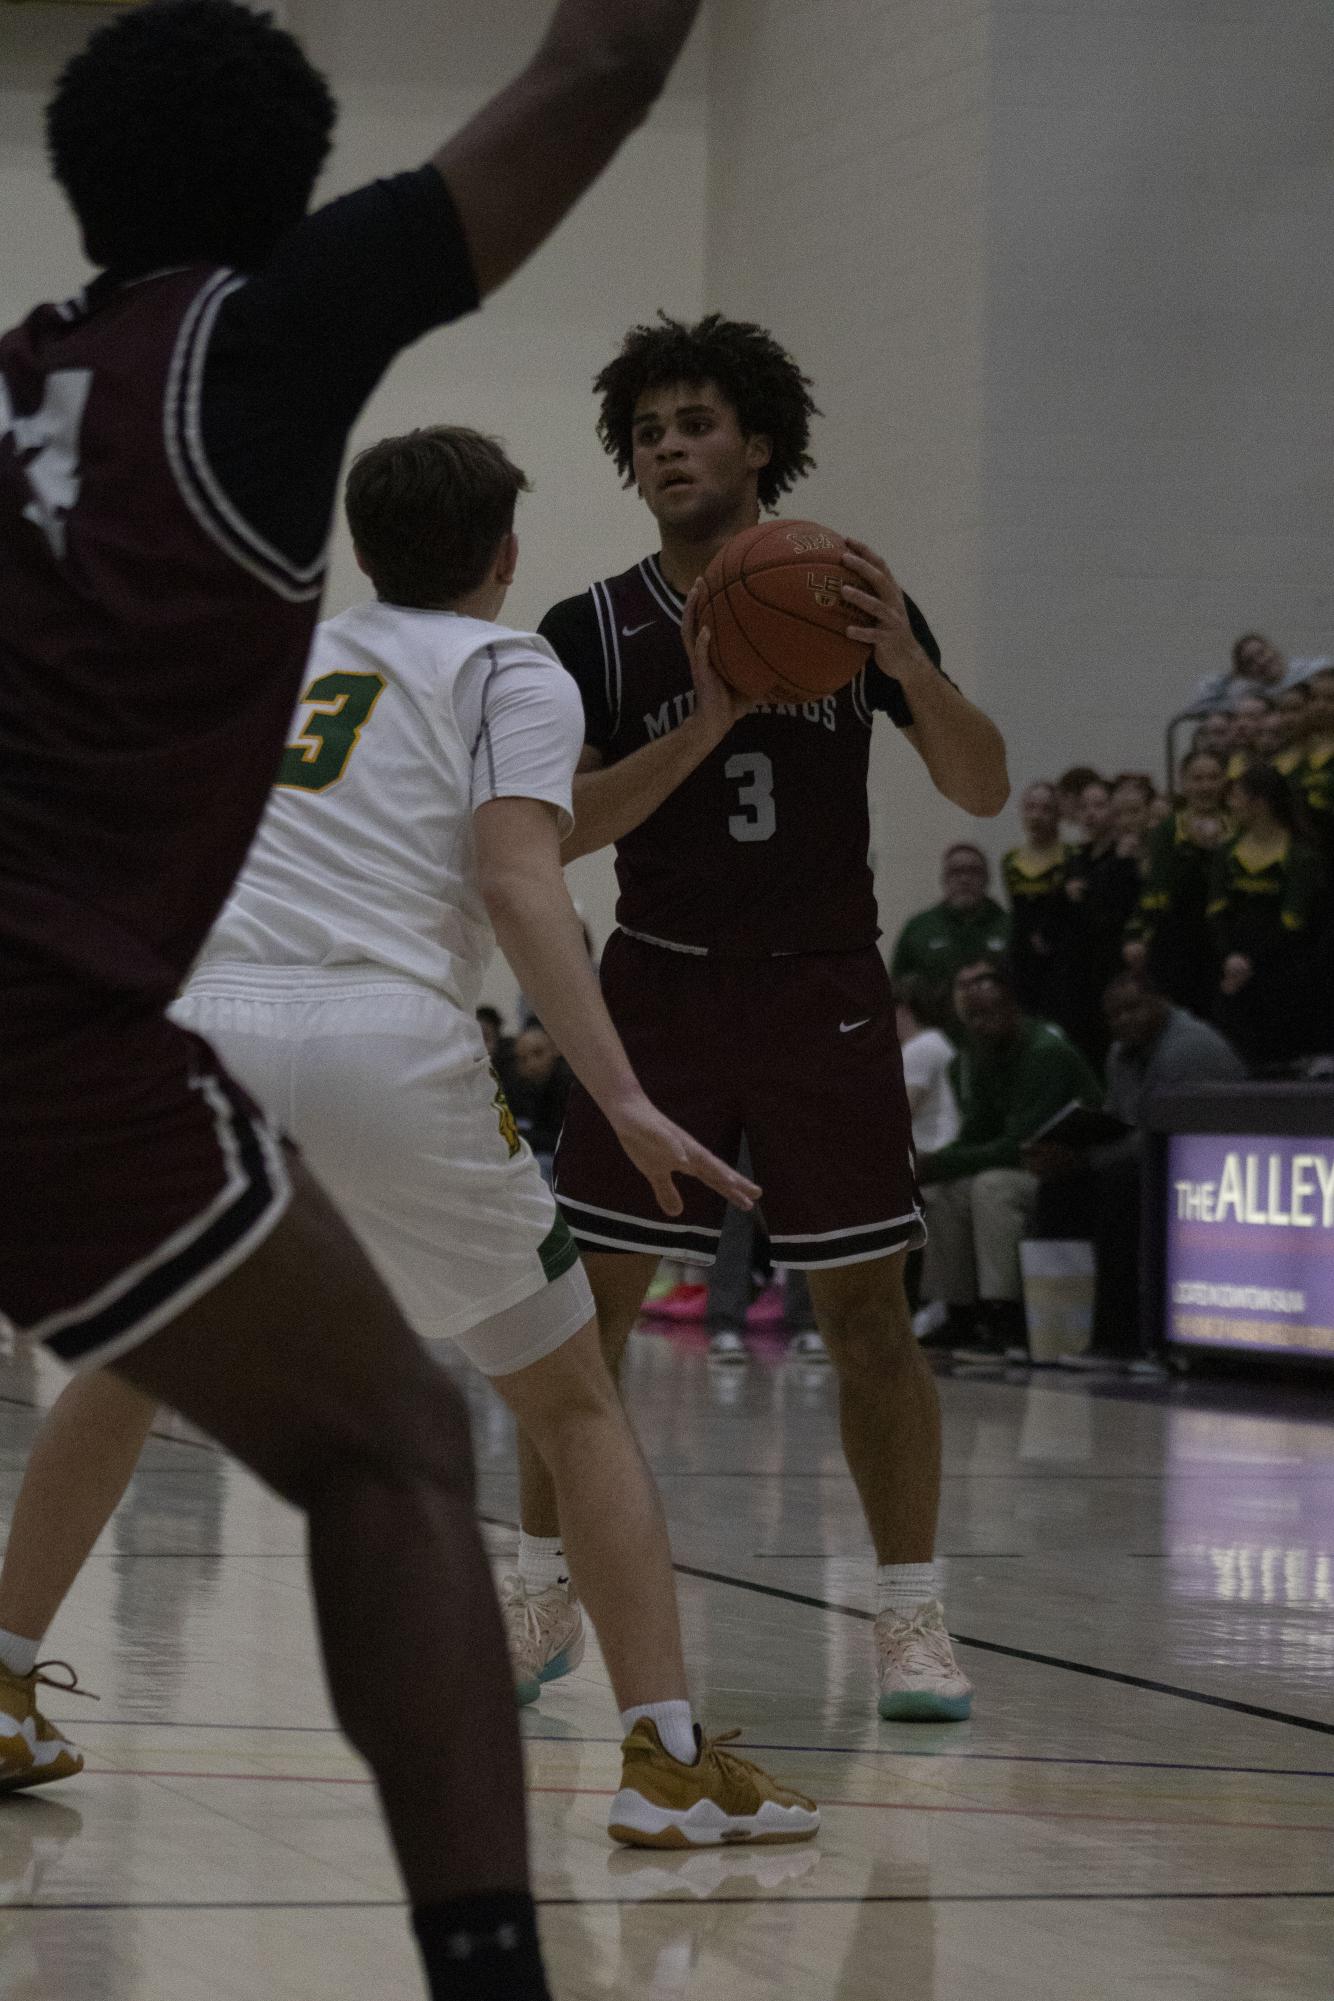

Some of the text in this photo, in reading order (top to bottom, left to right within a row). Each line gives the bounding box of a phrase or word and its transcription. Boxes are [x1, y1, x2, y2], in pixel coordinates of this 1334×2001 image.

[274, 671, 387, 793] 3
[723, 752, 777, 842] 3
[1174, 1152, 1334, 1229] THE ALLEY
